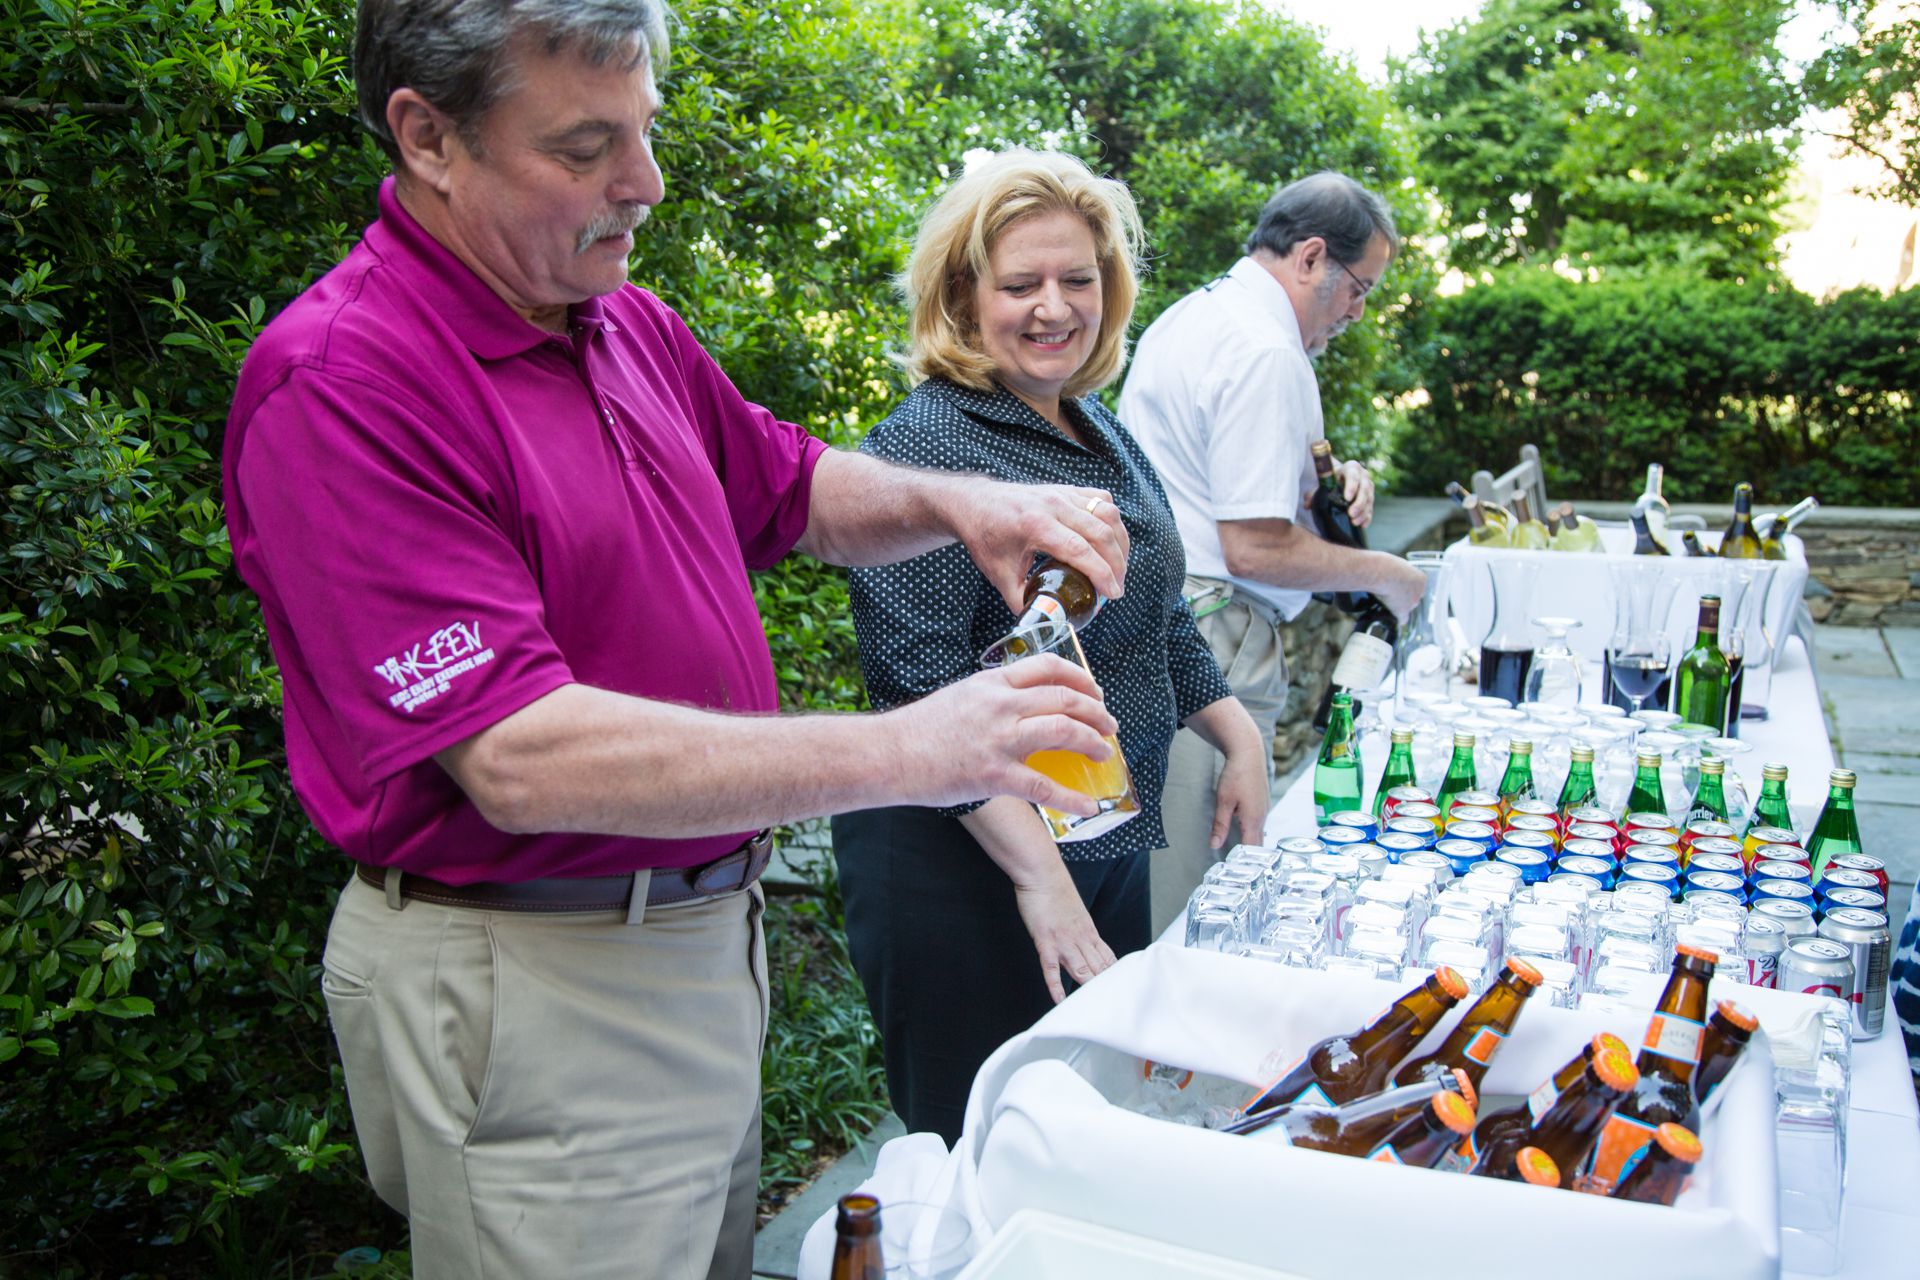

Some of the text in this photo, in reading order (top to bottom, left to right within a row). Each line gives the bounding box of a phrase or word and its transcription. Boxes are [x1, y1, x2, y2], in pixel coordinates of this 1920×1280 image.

[389, 648, 495, 708] KIDS ENJOY EXERCISE NOW
